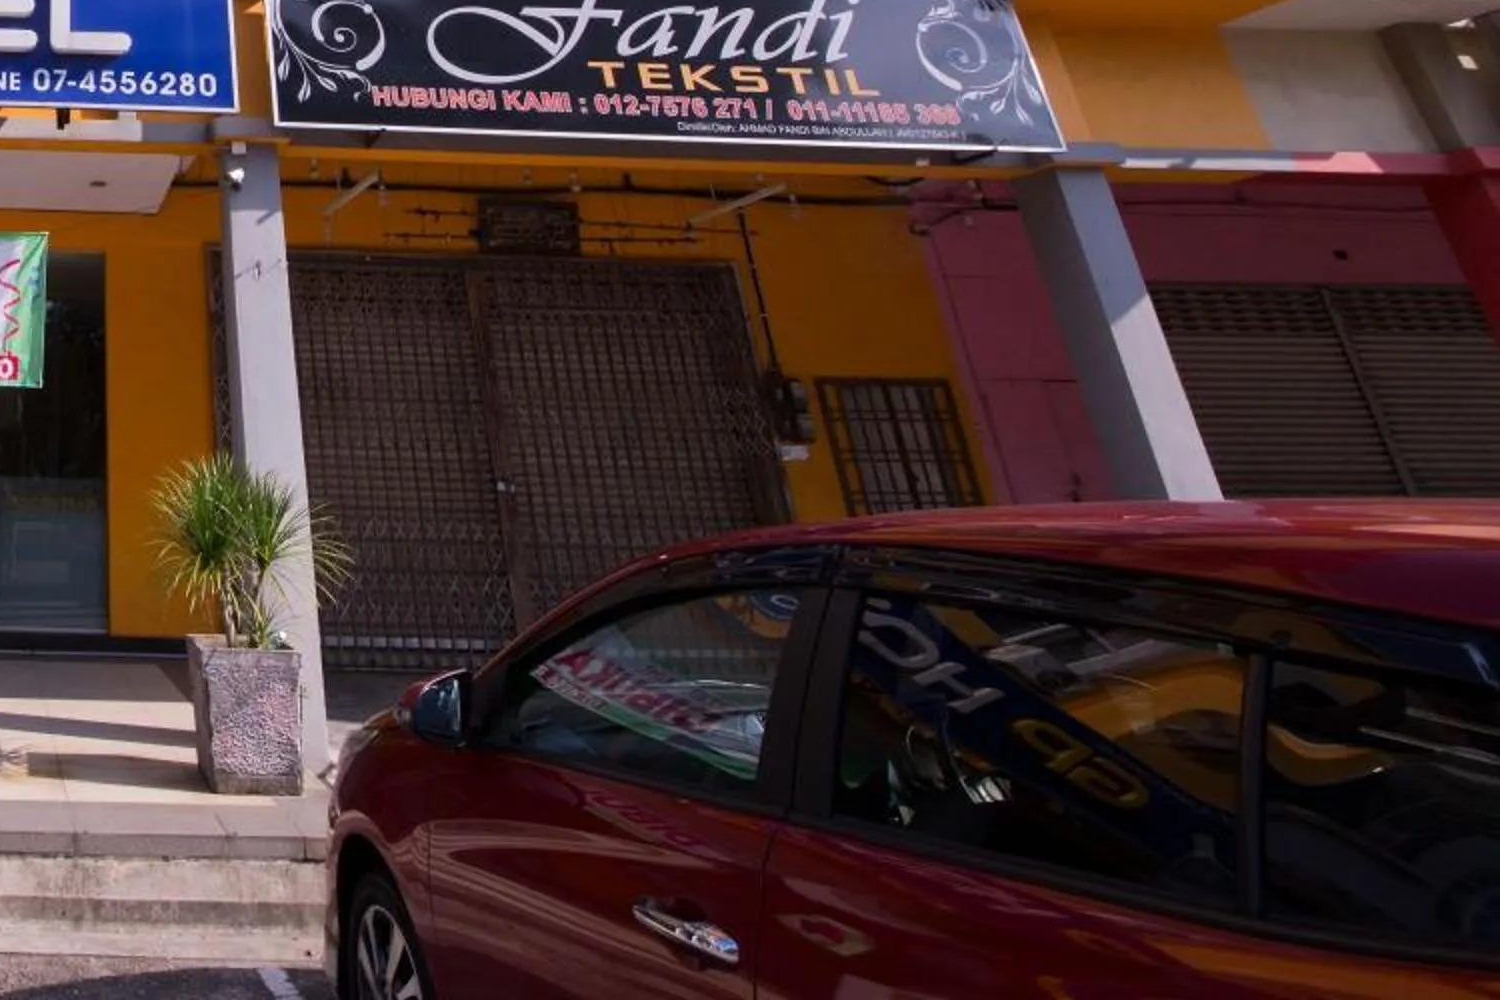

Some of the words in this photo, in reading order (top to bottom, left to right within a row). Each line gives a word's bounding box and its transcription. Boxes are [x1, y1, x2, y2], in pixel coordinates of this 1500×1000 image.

[32, 68, 218, 97] 07-4556280
[586, 60, 882, 97] TEKSTIL
[371, 85, 497, 112] HUBUNGI
[501, 89, 574, 113] KAMI
